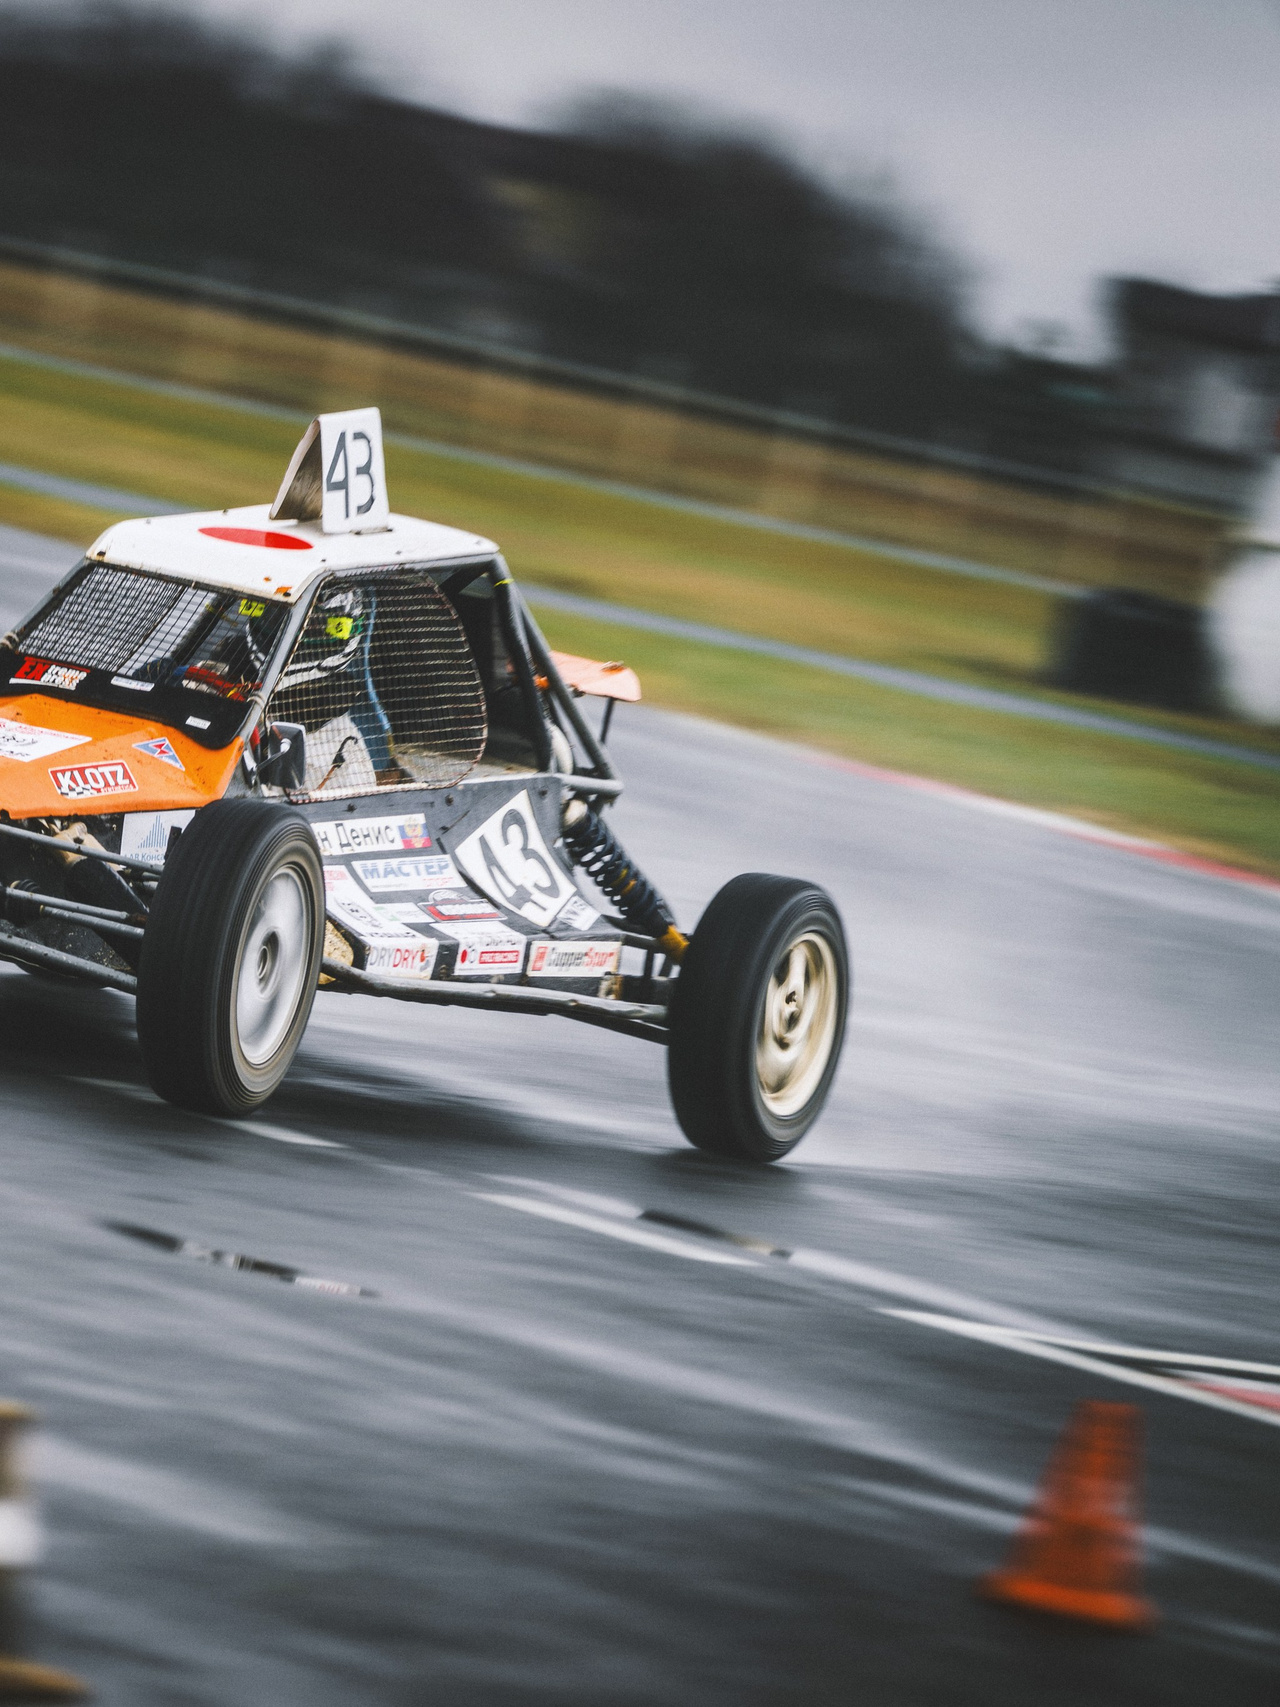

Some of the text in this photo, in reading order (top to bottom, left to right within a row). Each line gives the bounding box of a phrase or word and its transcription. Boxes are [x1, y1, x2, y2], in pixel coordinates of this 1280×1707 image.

[326, 431, 375, 519] 43
[56, 765, 130, 793] KLOTZ
[334, 822, 396, 853] Денис
[359, 857, 451, 880] МАСТЕР
[478, 808, 561, 912] 43
